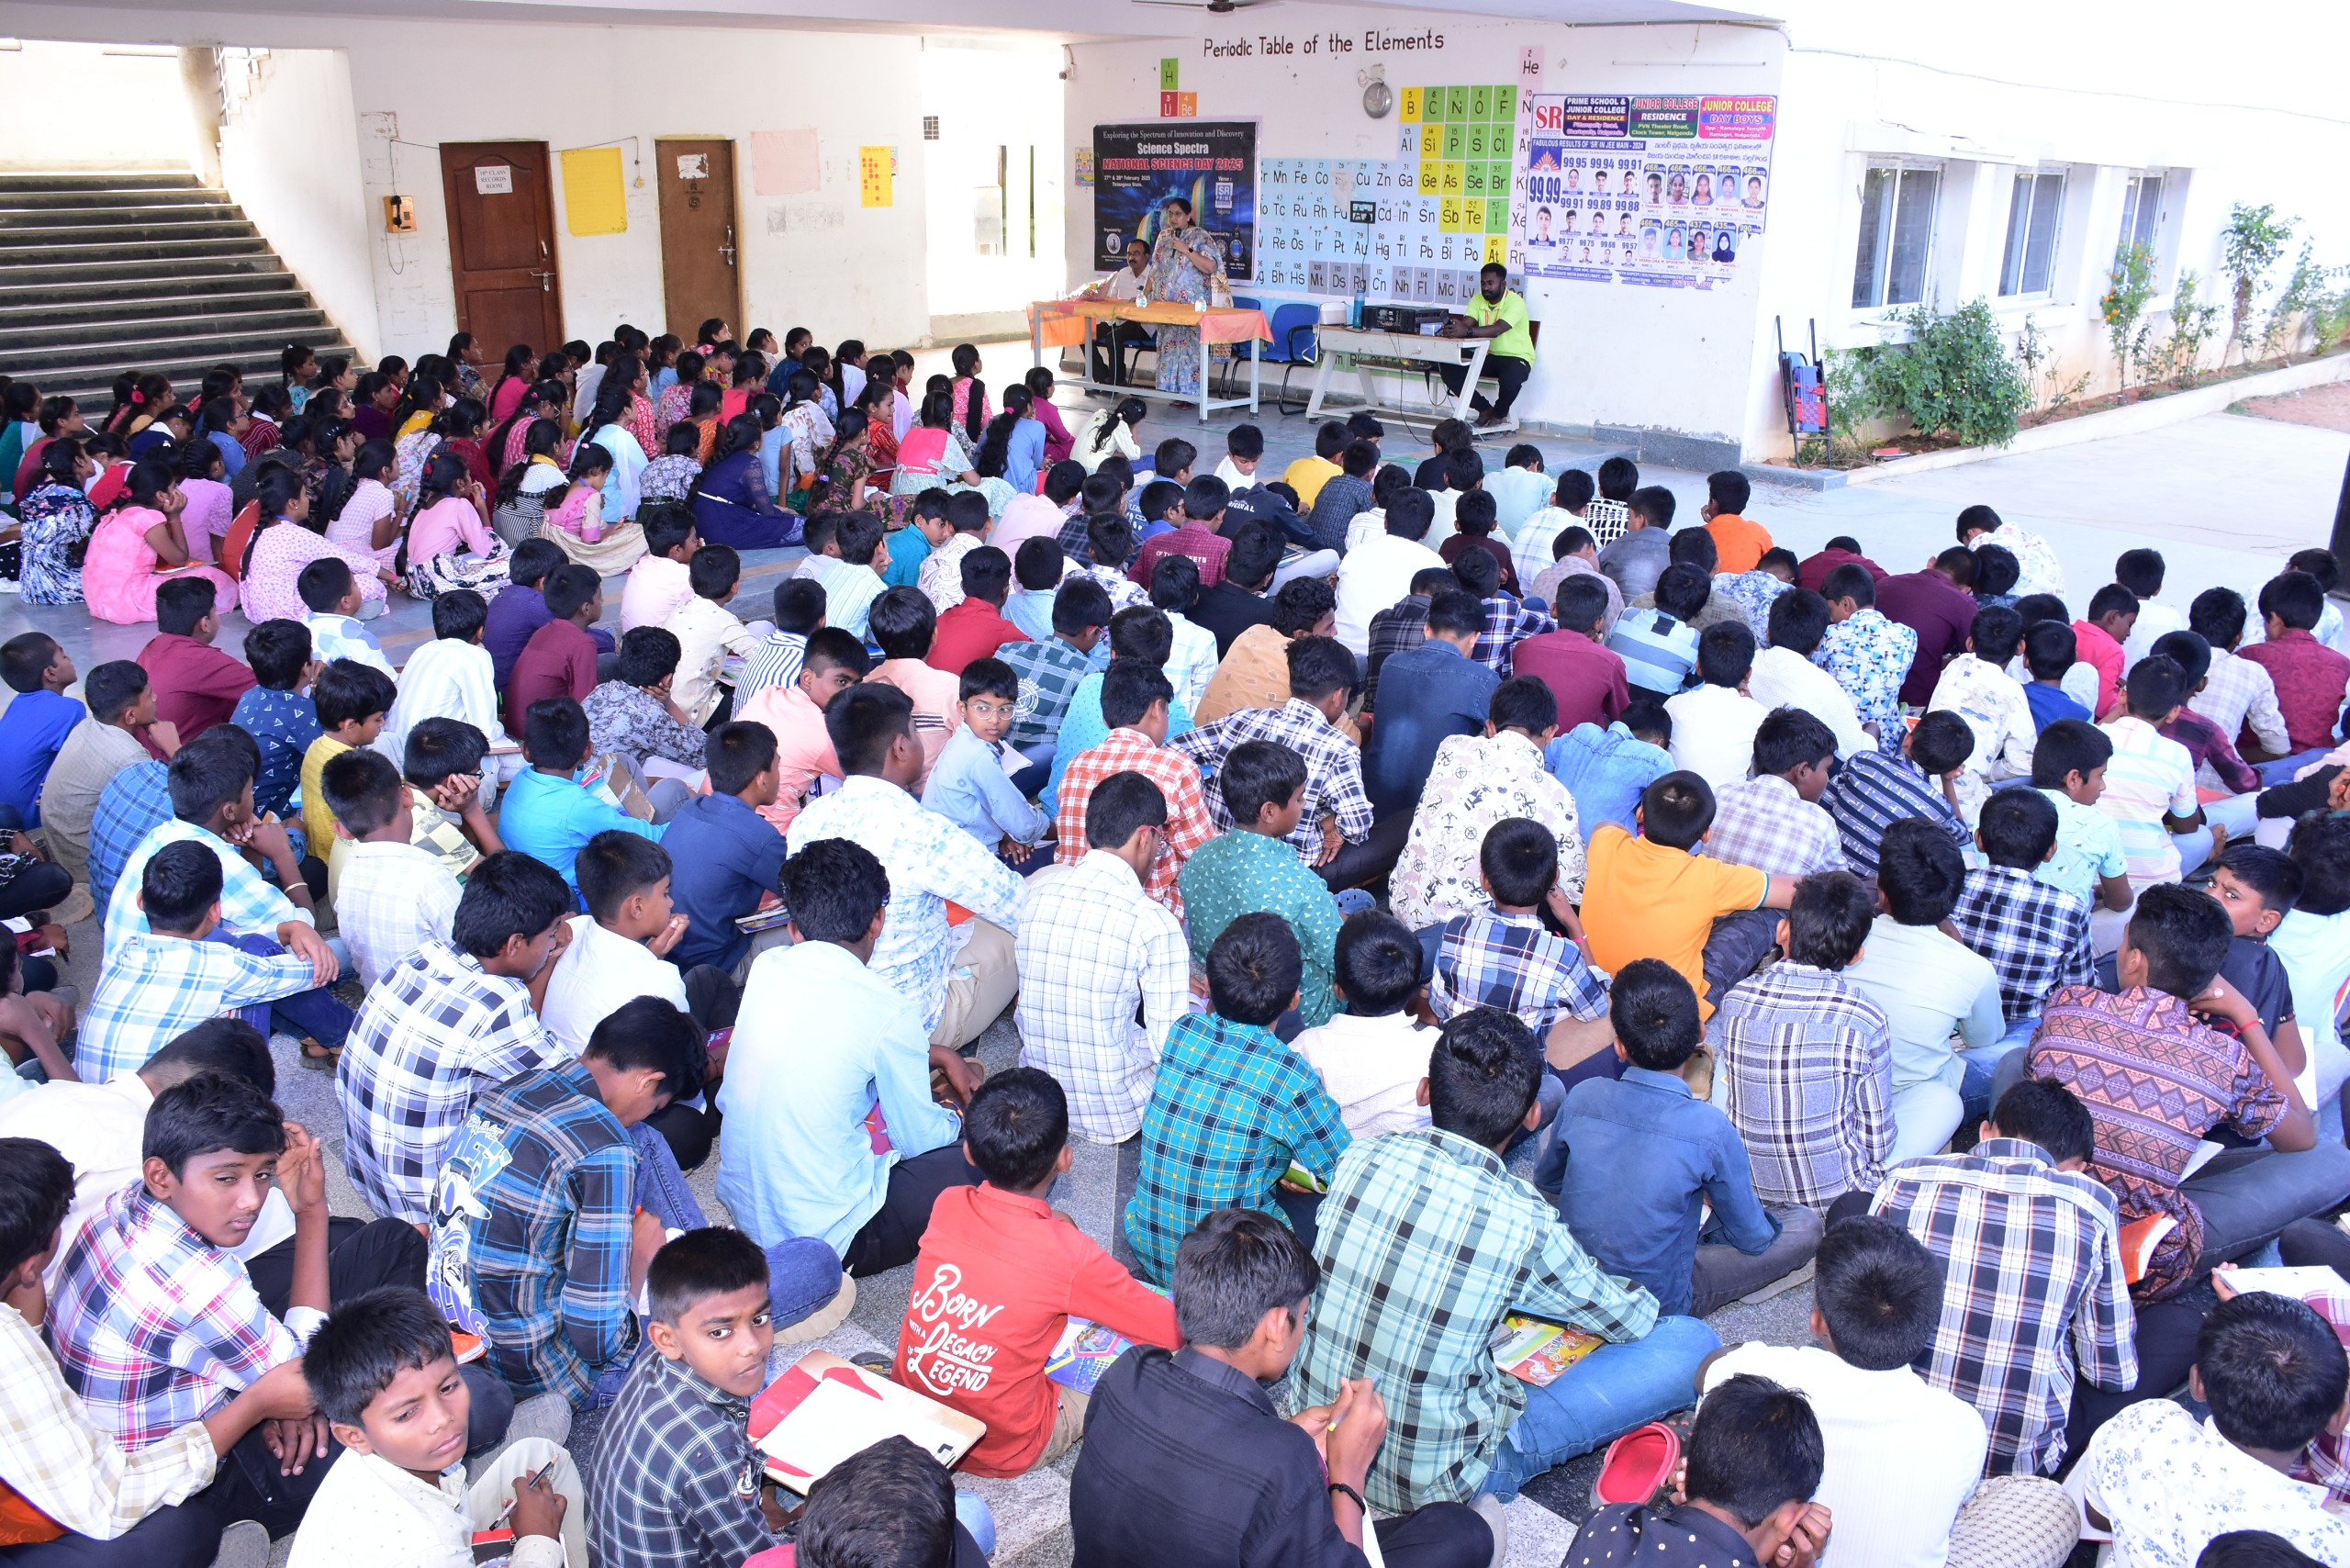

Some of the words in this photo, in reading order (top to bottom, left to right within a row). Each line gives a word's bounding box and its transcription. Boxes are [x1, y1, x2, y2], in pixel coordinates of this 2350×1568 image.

[1204, 38, 1252, 57] Periodic
[1259, 36, 1293, 55] Table
[1304, 34, 1319, 53] of
[1329, 33, 1353, 52] the
[1365, 29, 1444, 51] Elements
[1523, 60, 1539, 74] He
[1166, 71, 1173, 82] H
[1182, 104, 1192, 116] Be
[1407, 101, 1415, 114] B
[1429, 101, 1437, 114] C
[1452, 101, 1462, 114] N
[1475, 101, 1483, 114] O
[1500, 101, 1508, 114] F
[1632, 98, 1662, 109] JUNIOR
[1663, 98, 1698, 109] COLLEGE
[1703, 101, 1732, 111] JUNIOR
[1735, 102, 1773, 112] COLLEGE
[1535, 106, 1562, 129] SR
[1103, 131, 1129, 140] Exploring
[1140, 130, 1166, 140] Spectrum
[1217, 130, 1244, 139] Discovery
[1137, 143, 1172, 154] Science
[1174, 142, 1209, 155] Spectra
[1401, 138, 1412, 152] Al
[1424, 138, 1435, 151] Si
[1451, 138, 1459, 151] P
[1473, 138, 1481, 151] S
[1494, 138, 1505, 152] Cl
[1103, 158, 1150, 170] NATIONAL
[1151, 158, 1193, 170] SCIENCE
[1195, 158, 1214, 170] DAY
[1215, 158, 1244, 171] 2025
[1563, 157, 1587, 168] 99.95
[1590, 158, 1614, 169] 99.94
[1618, 159, 1642, 170] 99.91
[1274, 170, 1287, 183] Mn
[1295, 171, 1307, 184] Fe
[1315, 171, 1328, 184] Co
[1356, 173, 1370, 186] Cu
[1377, 173, 1391, 186] Zn
[1399, 174, 1413, 187] Ga
[1422, 174, 1437, 188] Ge
[1444, 174, 1457, 188] As
[1467, 175, 1483, 189] Se
[1492, 176, 1506, 189] Br
[1219, 186, 1229, 195] SR
[1529, 176, 1561, 204] 99.99
[1561, 198, 1583, 209] 99.91
[1587, 199, 1611, 210] 99.89
[1615, 200, 1640, 211] 99.88
[1273, 203, 1285, 216] Tc
[1293, 204, 1307, 217] Ru
[1313, 204, 1327, 218] Rh
[1378, 207, 1391, 221] Cd
[1398, 208, 1408, 222] In
[1419, 209, 1435, 222] Sn
[1443, 210, 1459, 223] Sb
[1466, 210, 1481, 224] Te
[1273, 236, 1285, 249] Re
[1291, 238, 1303, 250] Os
[1334, 240, 1344, 253] Pt
[1354, 241, 1368, 255] Au
[1376, 243, 1389, 260] Hg
[1420, 245, 1433, 259] Pb
[1442, 246, 1451, 260] Bi
[1465, 248, 1478, 261] Po
[1489, 249, 1499, 263] At
[1272, 270, 1284, 283] Bh
[1310, 273, 1323, 286] Mt
[1332, 275, 1346, 288] Ds
[1373, 278, 1386, 291] Cn
[1395, 280, 1409, 293] Nh
[1227, 500, 1255, 513] RIGINAL
[912, 1263, 1005, 1330] BORN
[909, 1318, 921, 1334] WITH
[915, 1321, 998, 1363] LEGACY
